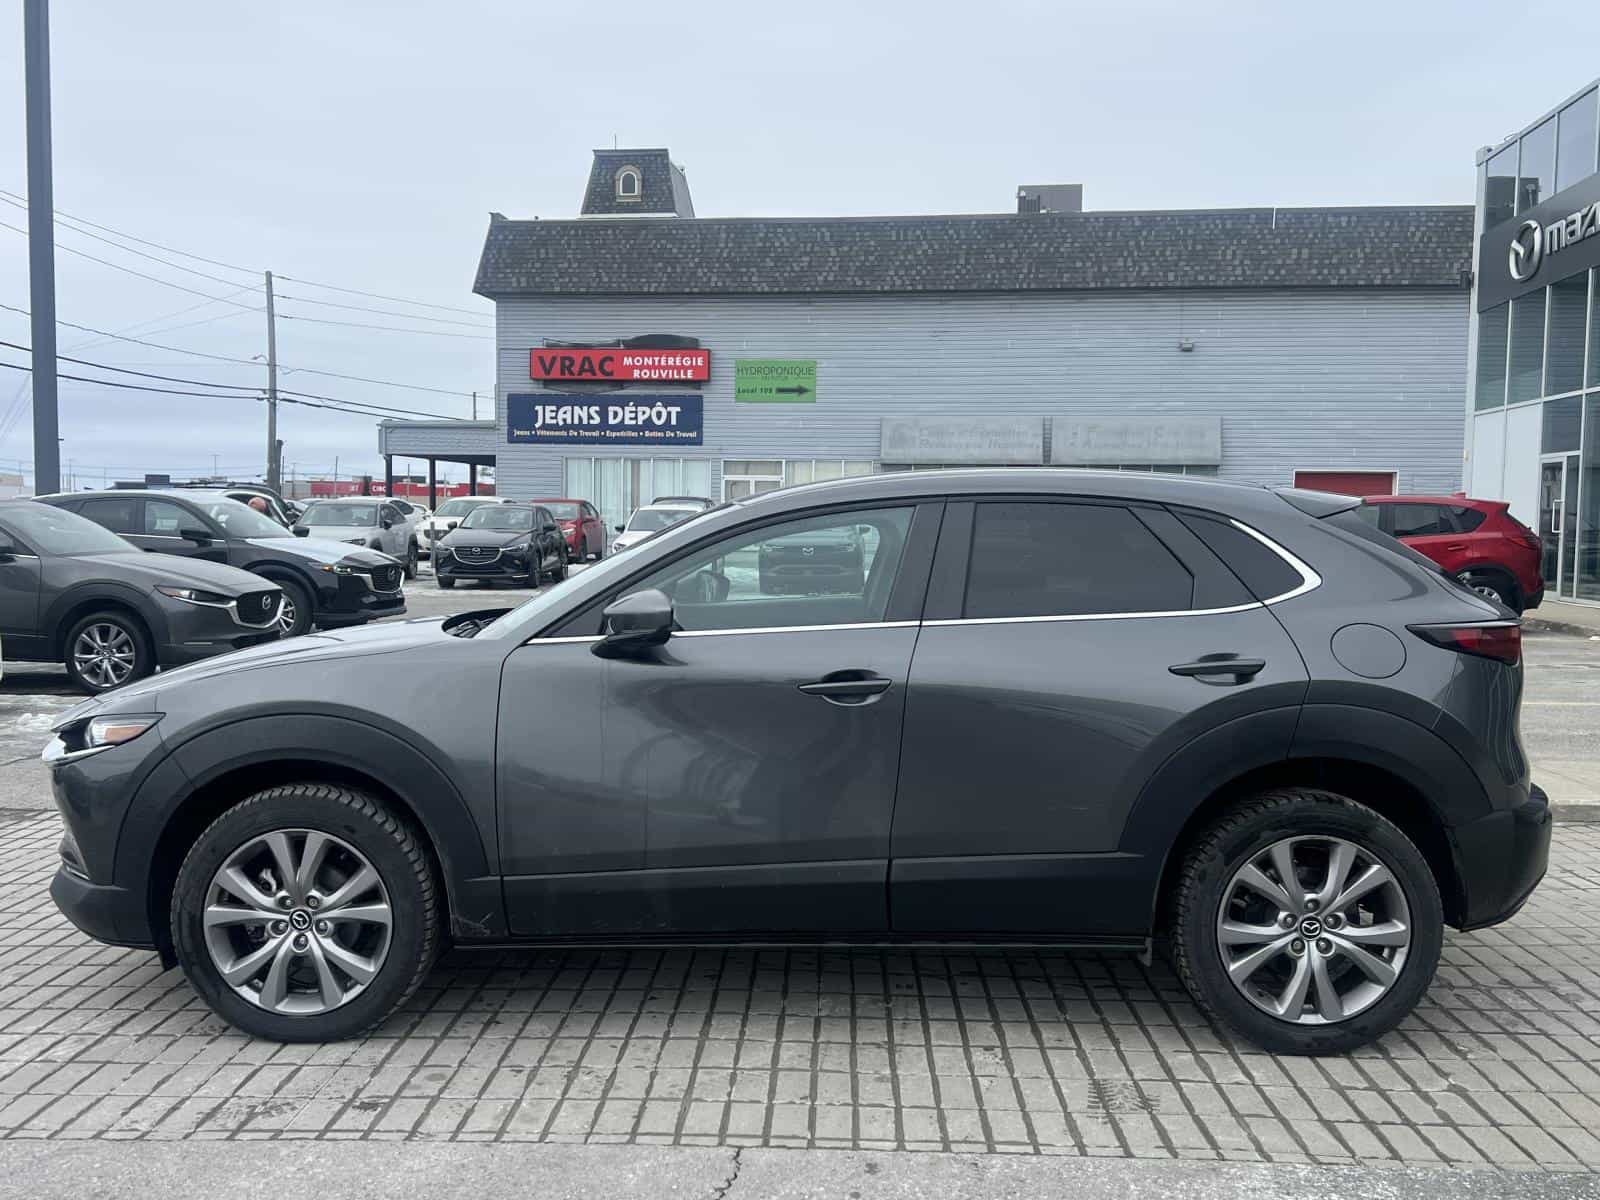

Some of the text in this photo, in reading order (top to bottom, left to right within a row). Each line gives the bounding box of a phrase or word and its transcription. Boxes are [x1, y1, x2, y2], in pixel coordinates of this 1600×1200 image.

[1545, 199, 1600, 256] maz
[538, 355, 615, 377] VRAC
[623, 354, 705, 367] MONTÉRÉGIE
[633, 369, 694, 379] ROUVILLE
[737, 366, 815, 377] HYDROPONIQUE
[534, 401, 681, 428] JEANS DÉPÔT
